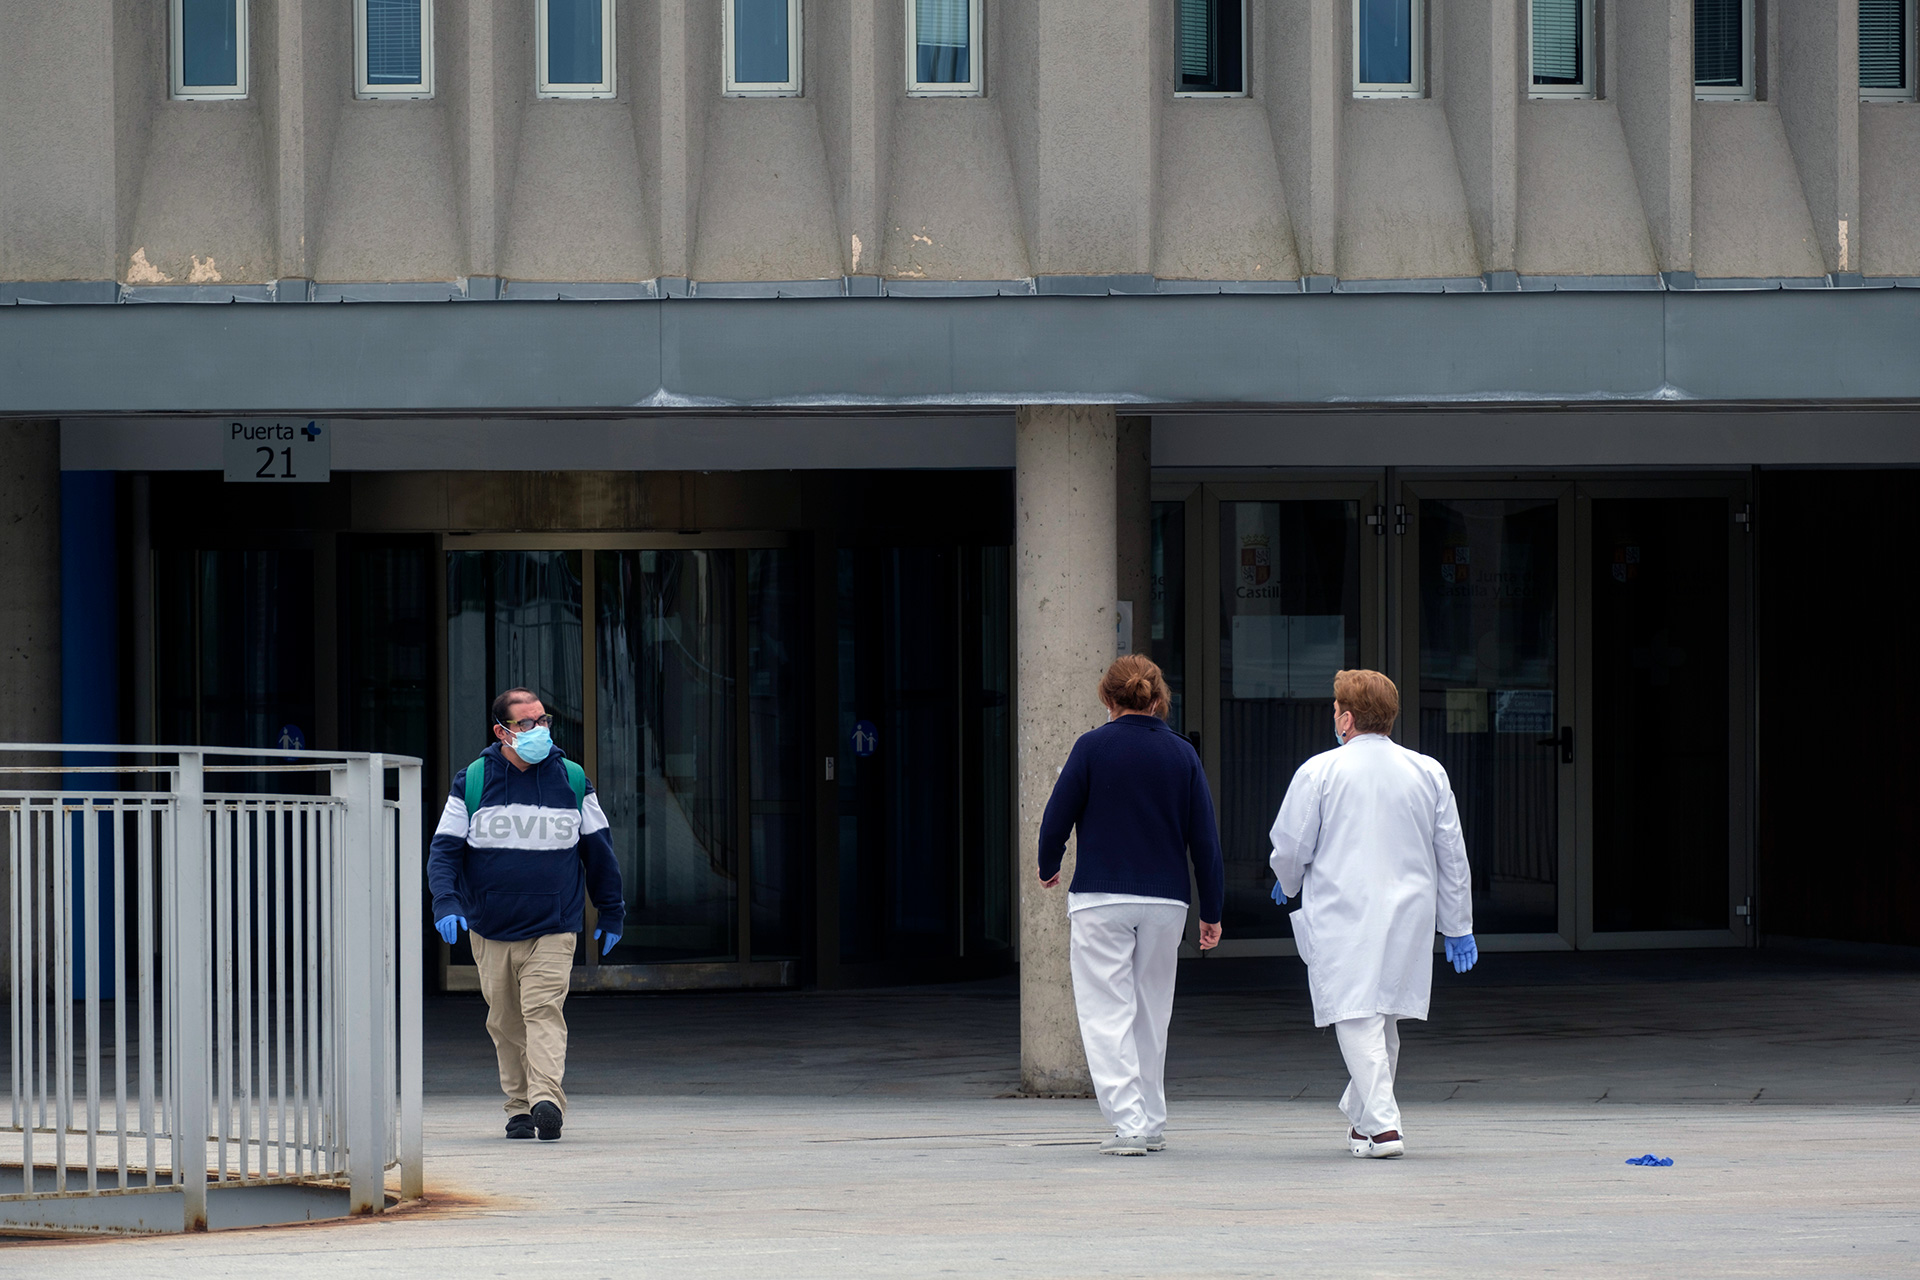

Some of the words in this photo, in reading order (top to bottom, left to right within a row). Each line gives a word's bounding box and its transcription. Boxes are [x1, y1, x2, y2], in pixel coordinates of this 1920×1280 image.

[231, 422, 294, 440] Puerta
[255, 446, 297, 478] 21
[1235, 586, 1288, 599] Castilla
[1435, 584, 1487, 597] Castilla
